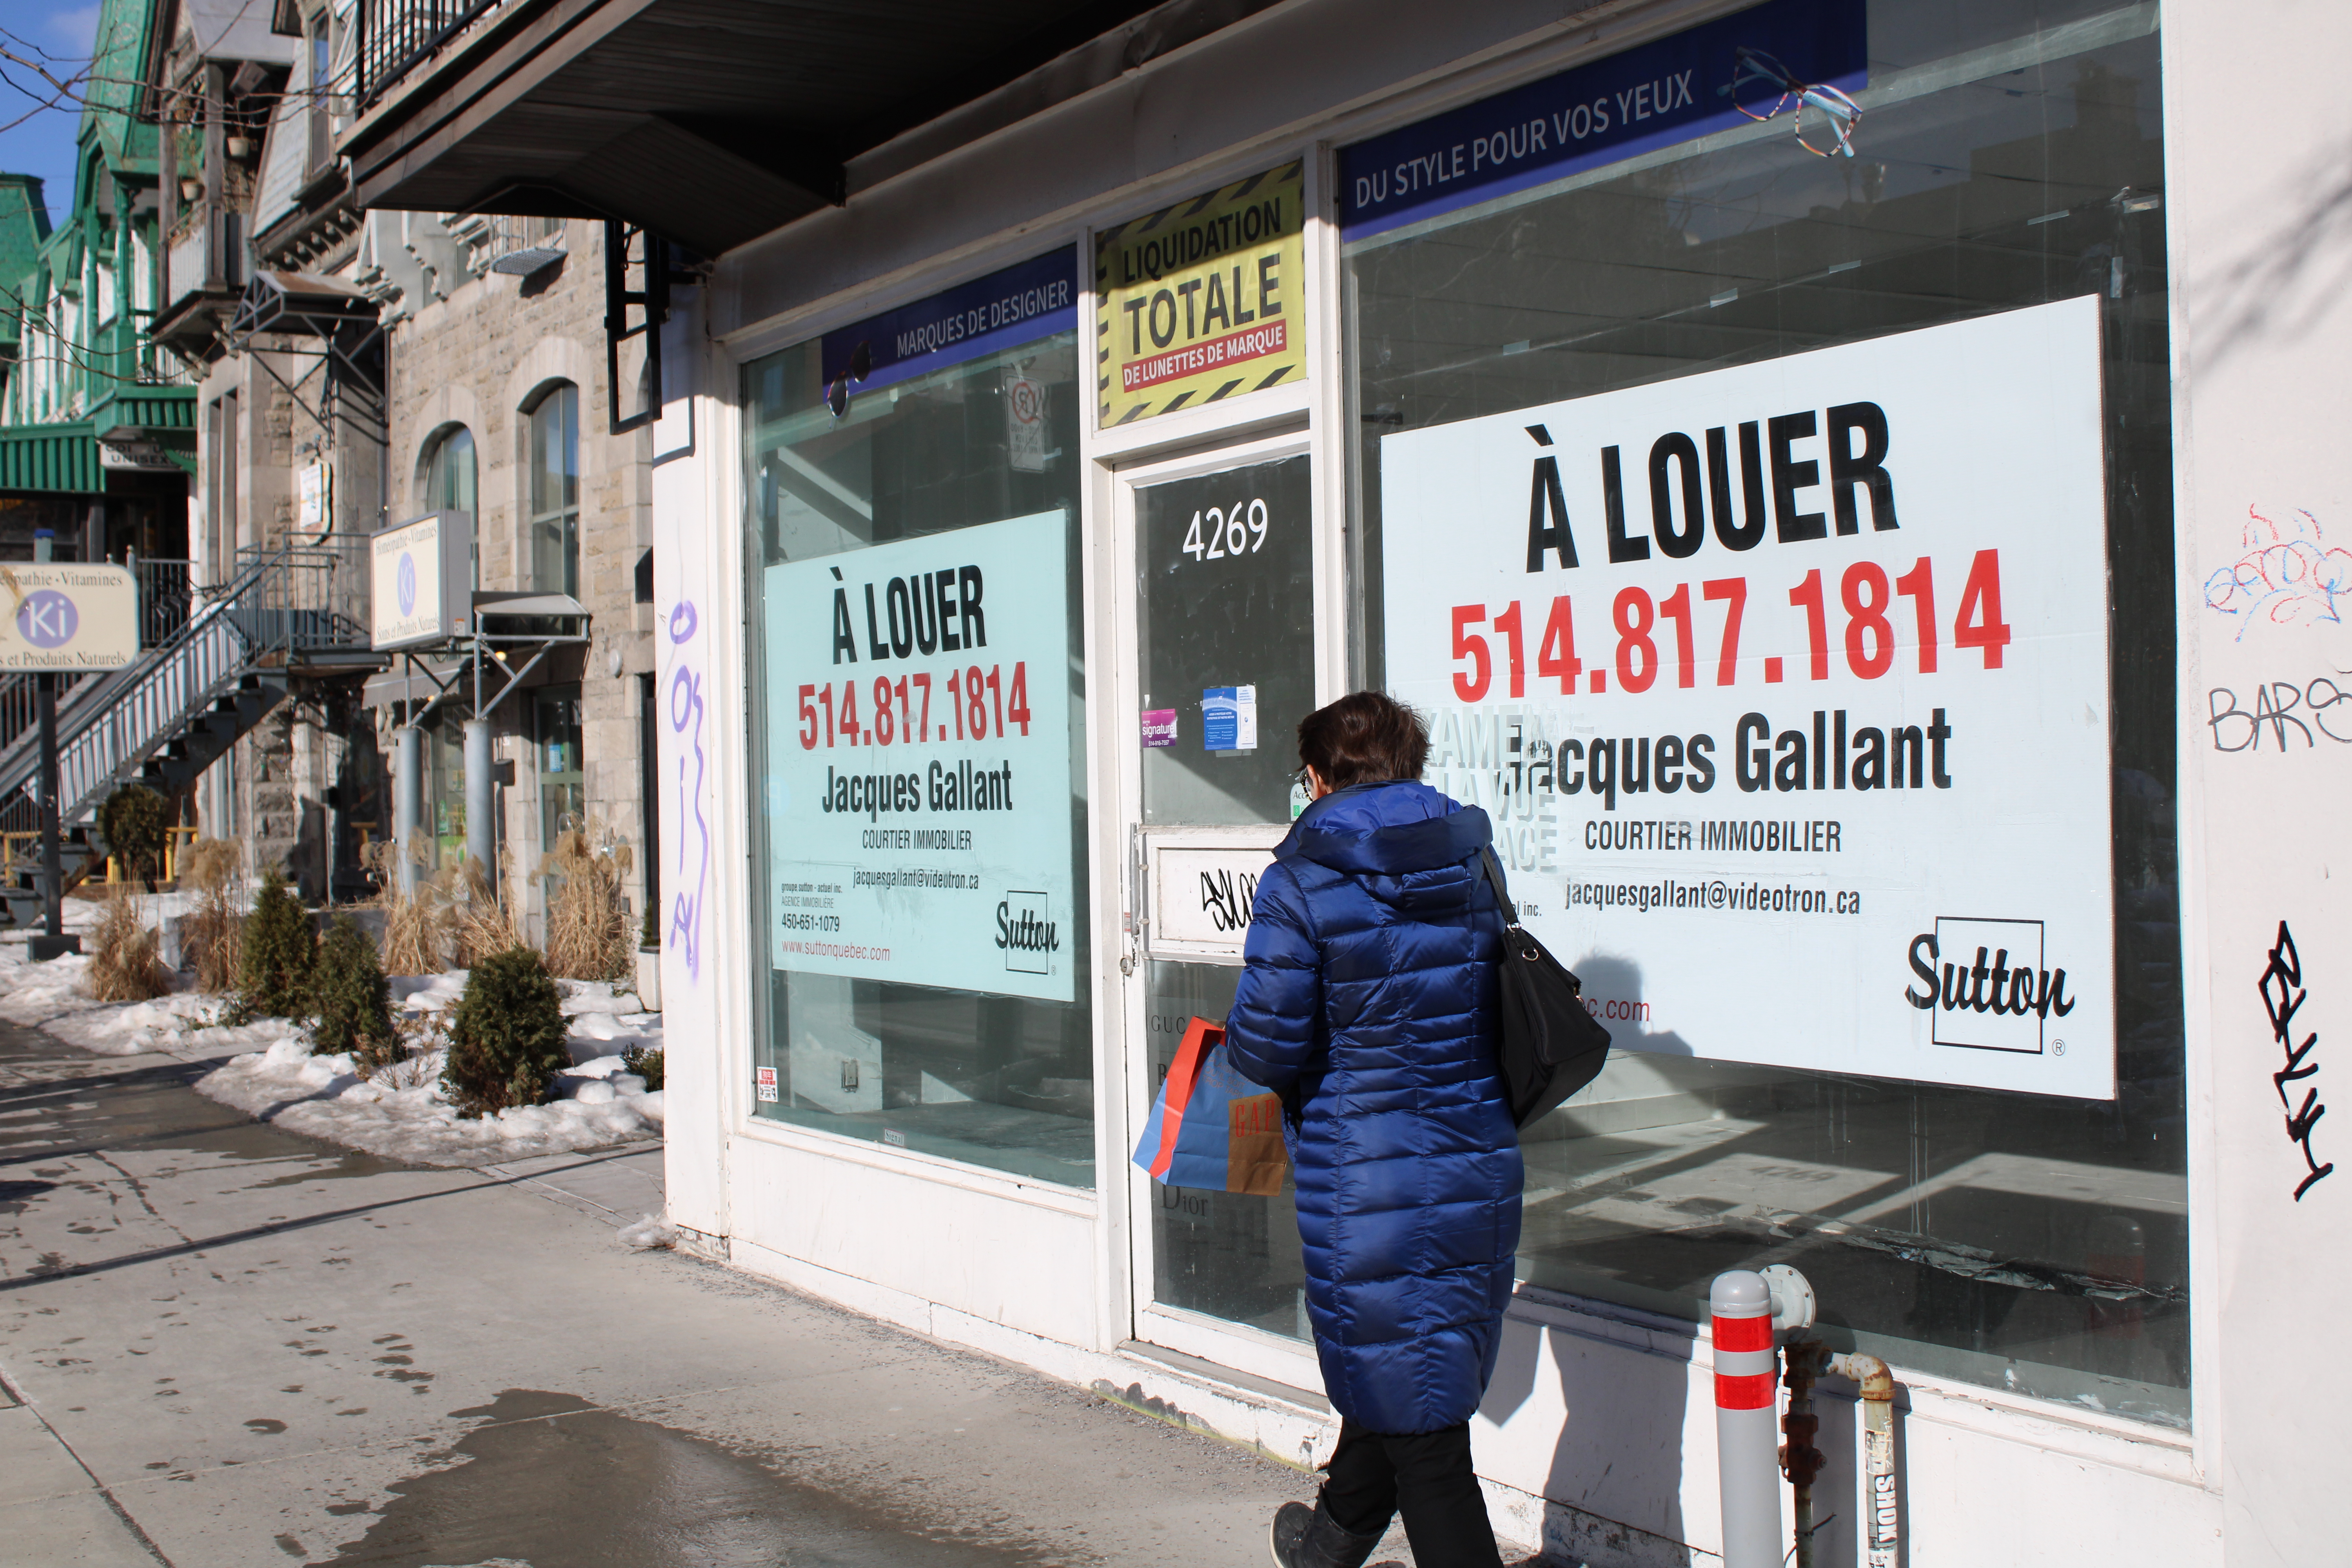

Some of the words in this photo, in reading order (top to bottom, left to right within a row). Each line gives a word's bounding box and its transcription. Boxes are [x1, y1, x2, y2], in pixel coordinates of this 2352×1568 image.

[1356, 169, 1387, 208] DU
[1394, 143, 1466, 196] STYLE
[1473, 118, 1547, 172] POUR
[1553, 98, 1610, 145] VOS
[1615, 69, 1693, 125] YEUX
[1123, 196, 1281, 283] LIQUIDATION
[897, 314, 964, 358] MARQUES
[968, 305, 987, 335] DE
[991, 279, 1069, 328] DESIGNER
[1123, 253, 1282, 356] TOTALE
[1123, 367, 1140, 387] DE
[1142, 347, 1204, 382] LUNETTES
[1207, 342, 1224, 365] DE
[1227, 325, 1283, 359] MARQUE
[1524, 423, 1580, 573] À
[1601, 401, 1900, 564] LOUER
[410, 524, 437, 544] Vitamines
[1182, 497, 1268, 562] 4269
[60, 571, 122, 586] Vitamines
[399, 561, 412, 606] Ki
[29, 598, 67, 639] Ki
[376, 625, 389, 642] Soins
[396, 620, 417, 637] Produits
[417, 612, 439, 632] Naturels
[829, 566, 858, 665] À
[864, 564, 987, 661] LOUER
[1451, 548, 2011, 703] 514.817.1814
[7, 654, 18, 666] et
[22, 651, 73, 666] Produits
[76, 651, 126, 666] Naturels
[798, 661, 1031, 751] 514.817.1814
[1142, 723, 1174, 738] signature
[1735, 708, 1952, 793] Gallant
[822, 765, 920, 823] Jacques
[928, 759, 1013, 812] Gallant
[1486, 766, 1550, 816] VUE
[862, 829, 910, 850] COURTIER
[913, 830, 972, 851] IMMOBILIER
[1585, 820, 1692, 851] COURTIER
[1701, 820, 1841, 853] IMMOBILIER
[781, 882, 797, 894] groupe
[798, 882, 813, 893] sutton
[817, 883, 832, 893] actuel
[833, 883, 843, 893] inc.
[853, 867, 979, 890] jacquesgallant@videotron.ca
[1565, 877, 1860, 914] jacquesgallant@videotron.ca
[781, 896, 800, 907] AGENCE
[801, 895, 834, 909] IMMOBILIÈRE
[1523, 901, 1542, 917] inc.
[781, 913, 840, 932] 450-651-1079
[995, 901, 1059, 953] Sutton
[782, 940, 890, 961] www.suttonquebec.com
[1904, 934, 2075, 1020] Sutton
[1202, 1074, 1223, 1089] TROP
[1225, 1085, 1245, 1098] TARD
[1227, 1076, 1246, 1089] SOIT
[1235, 1100, 1275, 1138] GAP
[1160, 1183, 1208, 1216] Dior
